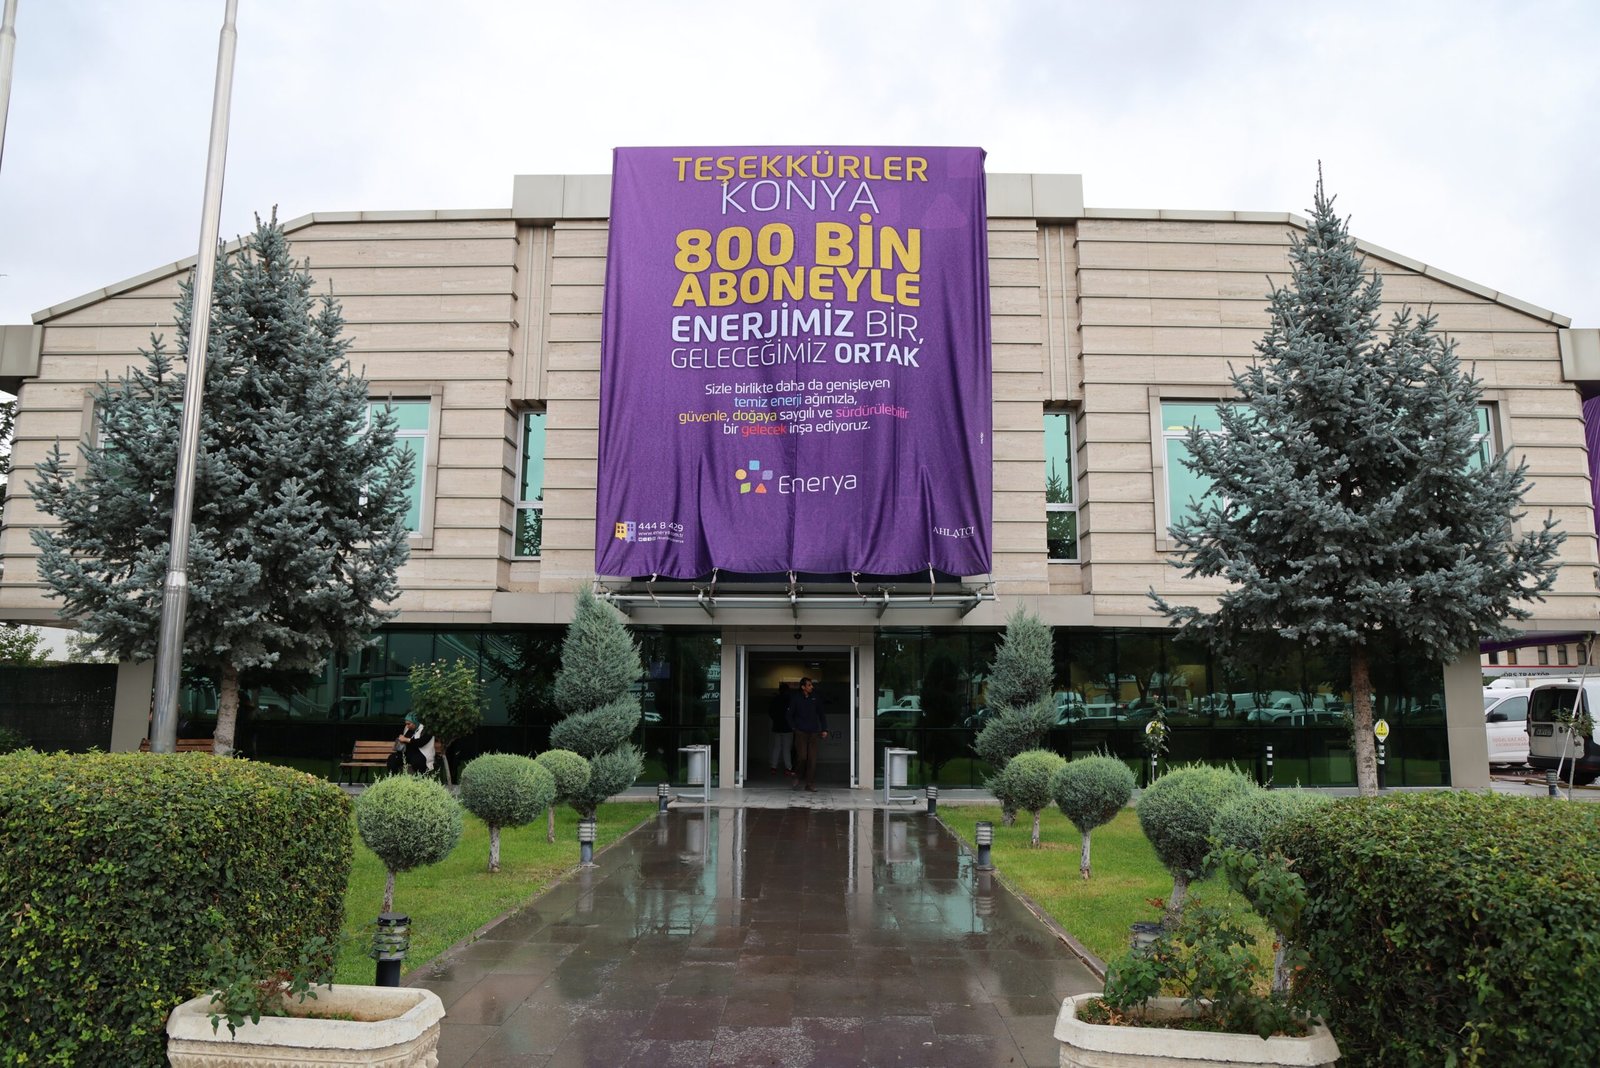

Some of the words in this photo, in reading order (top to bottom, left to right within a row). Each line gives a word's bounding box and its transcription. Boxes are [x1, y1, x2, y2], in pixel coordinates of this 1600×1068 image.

[672, 150, 928, 185] TEŞEKKÜRLER
[721, 179, 880, 214] KONYA
[674, 222, 794, 273] 800
[815, 213, 921, 273] BİN
[672, 266, 921, 307] ABONEYLE
[671, 302, 854, 343] ENERJİMİZ
[866, 306, 924, 345] BİR,
[671, 338, 827, 369] GELECEĞİMİZ
[834, 342, 920, 368] ORTAK
[705, 383, 732, 395] Sizle
[735, 382, 774, 394] birlikte
[775, 380, 805, 392] daha
[808, 379, 823, 391] da
[826, 379, 891, 393] genişleyen
[733, 397, 768, 408] temiz
[770, 394, 802, 408] enerji
[804, 393, 858, 407] ağımızla,
[679, 410, 730, 425] güvenle,
[732, 410, 777, 424] doğaya
[779, 407, 815, 422] saygılı
[817, 409, 833, 418] ve
[835, 403, 910, 419] sürdürülebilir
[723, 423, 739, 434] bir
[741, 424, 787, 437] gelecek
[789, 422, 813, 435] inşa
[815, 420, 871, 434] ediyoruz.
[778, 473, 857, 495] Enerya
[638, 521, 657, 530] 444
[659, 521, 666, 530] 8
[668, 522, 684, 532] 429
